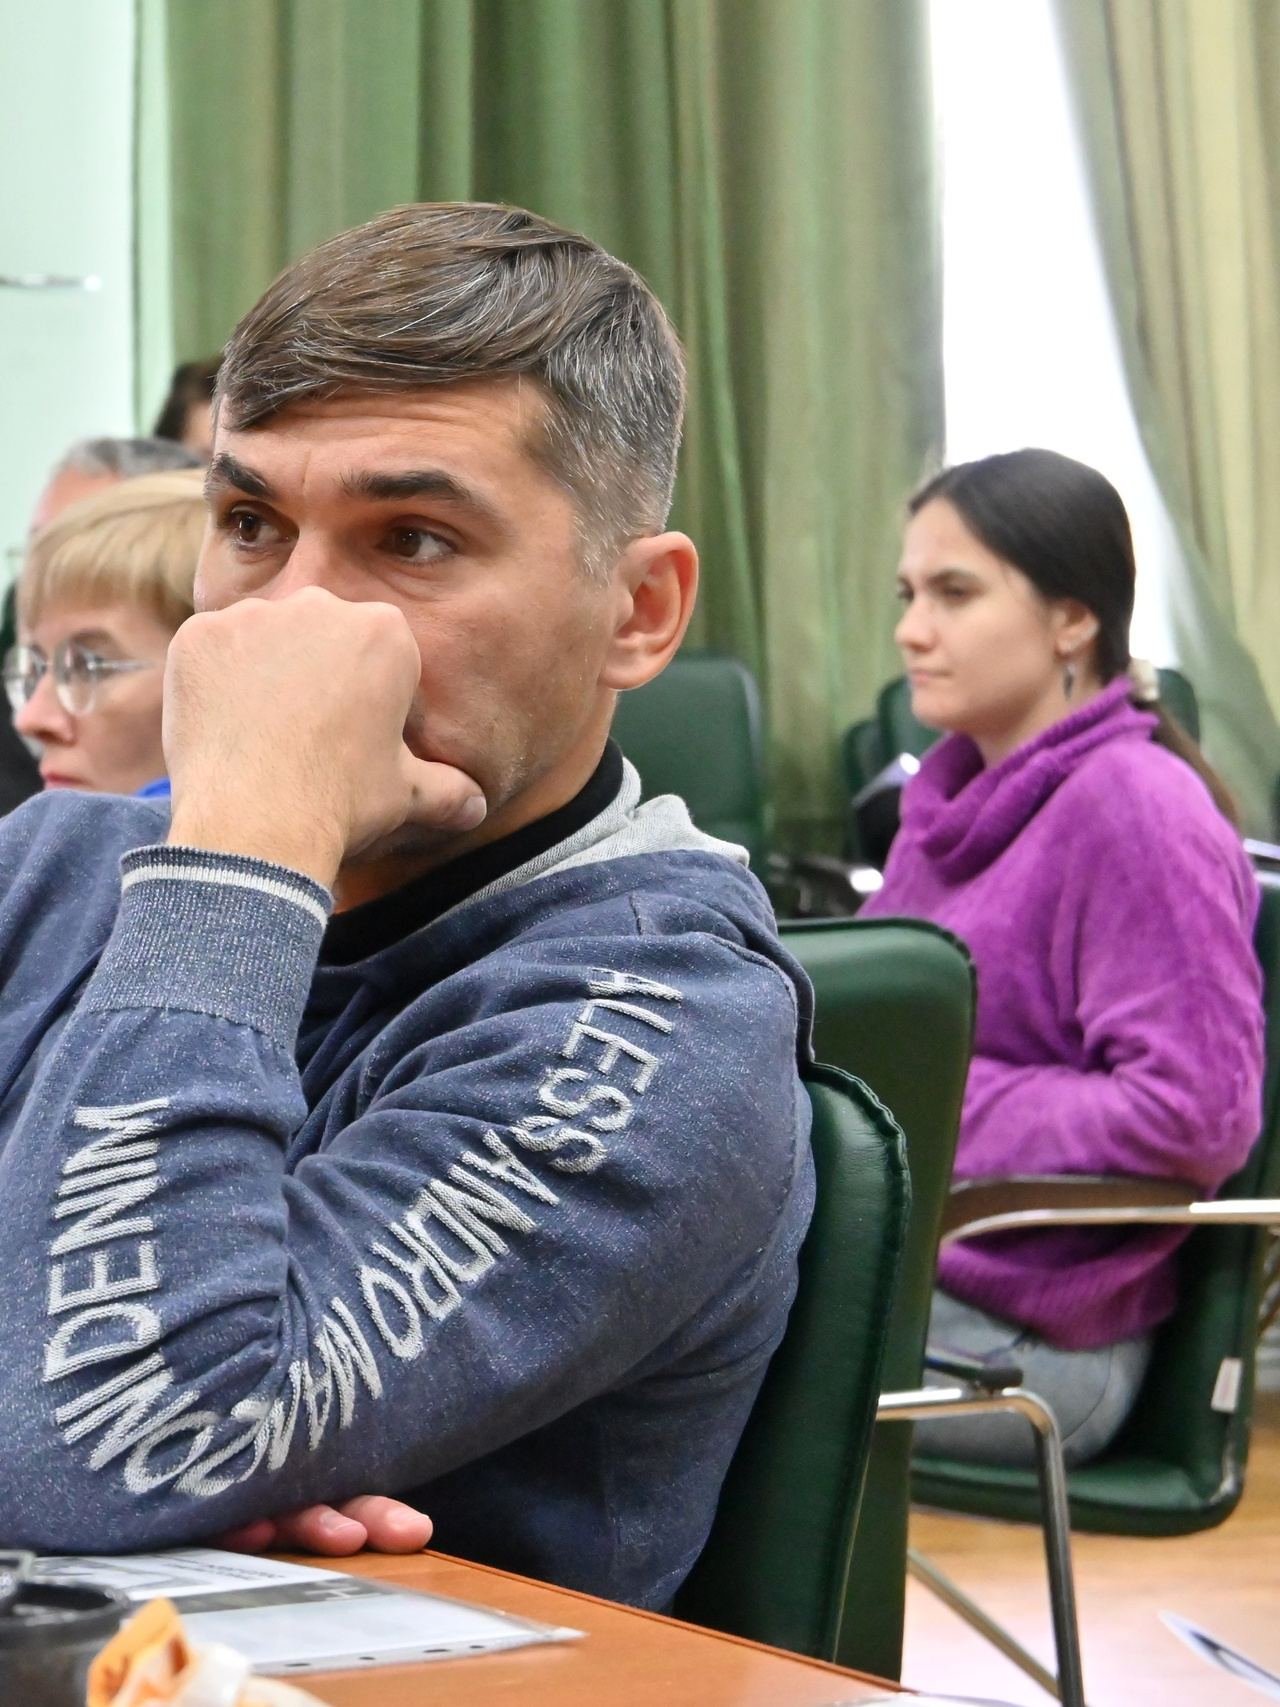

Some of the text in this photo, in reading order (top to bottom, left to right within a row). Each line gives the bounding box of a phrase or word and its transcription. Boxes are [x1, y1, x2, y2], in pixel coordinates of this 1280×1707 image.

[43, 966, 683, 1497] ALESSANDRO MANZONI DENIM
